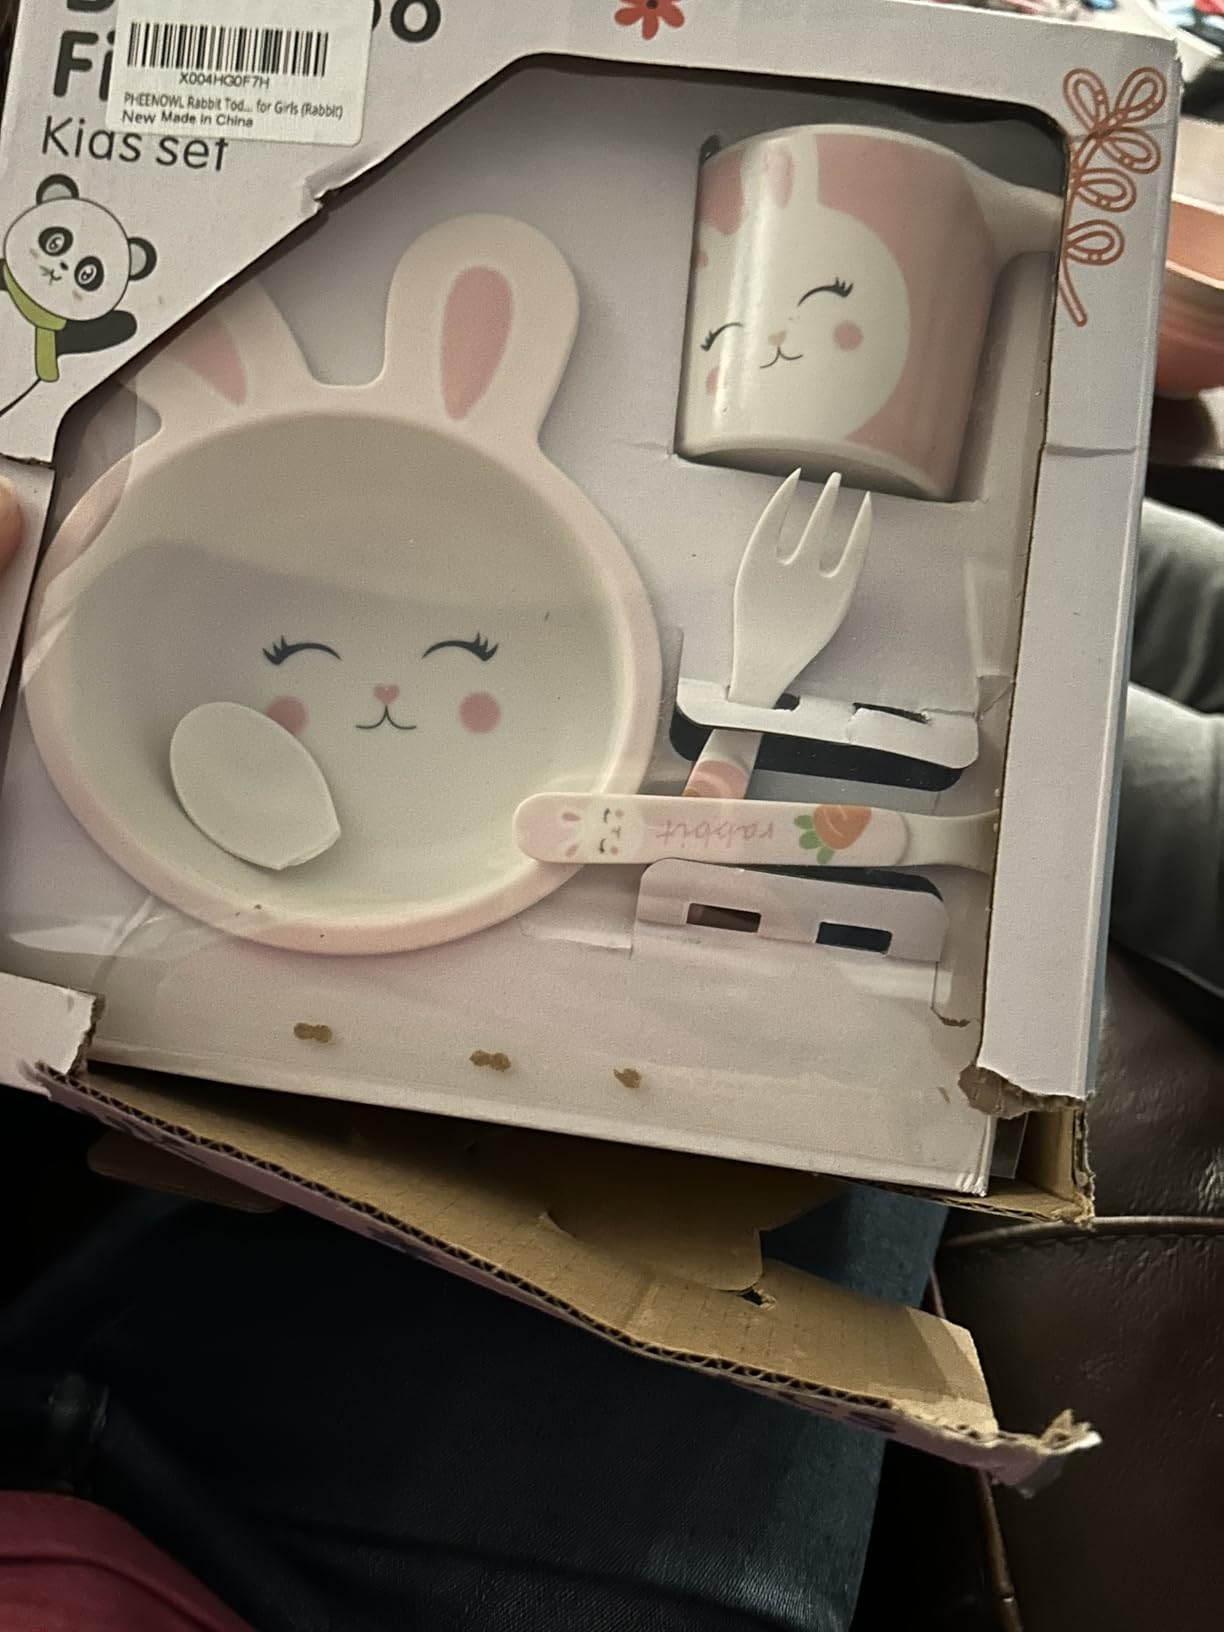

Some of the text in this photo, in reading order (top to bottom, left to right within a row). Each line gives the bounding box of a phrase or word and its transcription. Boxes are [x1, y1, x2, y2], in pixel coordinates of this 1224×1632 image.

[179, 71, 270, 89] X004HG0F7H
[121, 109, 254, 128] New Made in China
[124, 91, 184, 109] PHEENOWL
[187, 96, 221, 111] Rabbit
[256, 98, 271, 113] for
[274, 100, 299, 116] Girls
[301, 101, 344, 121] (Rabbit)
[155, 135, 229, 171] set
[656, 819, 774, 848] rabbit
